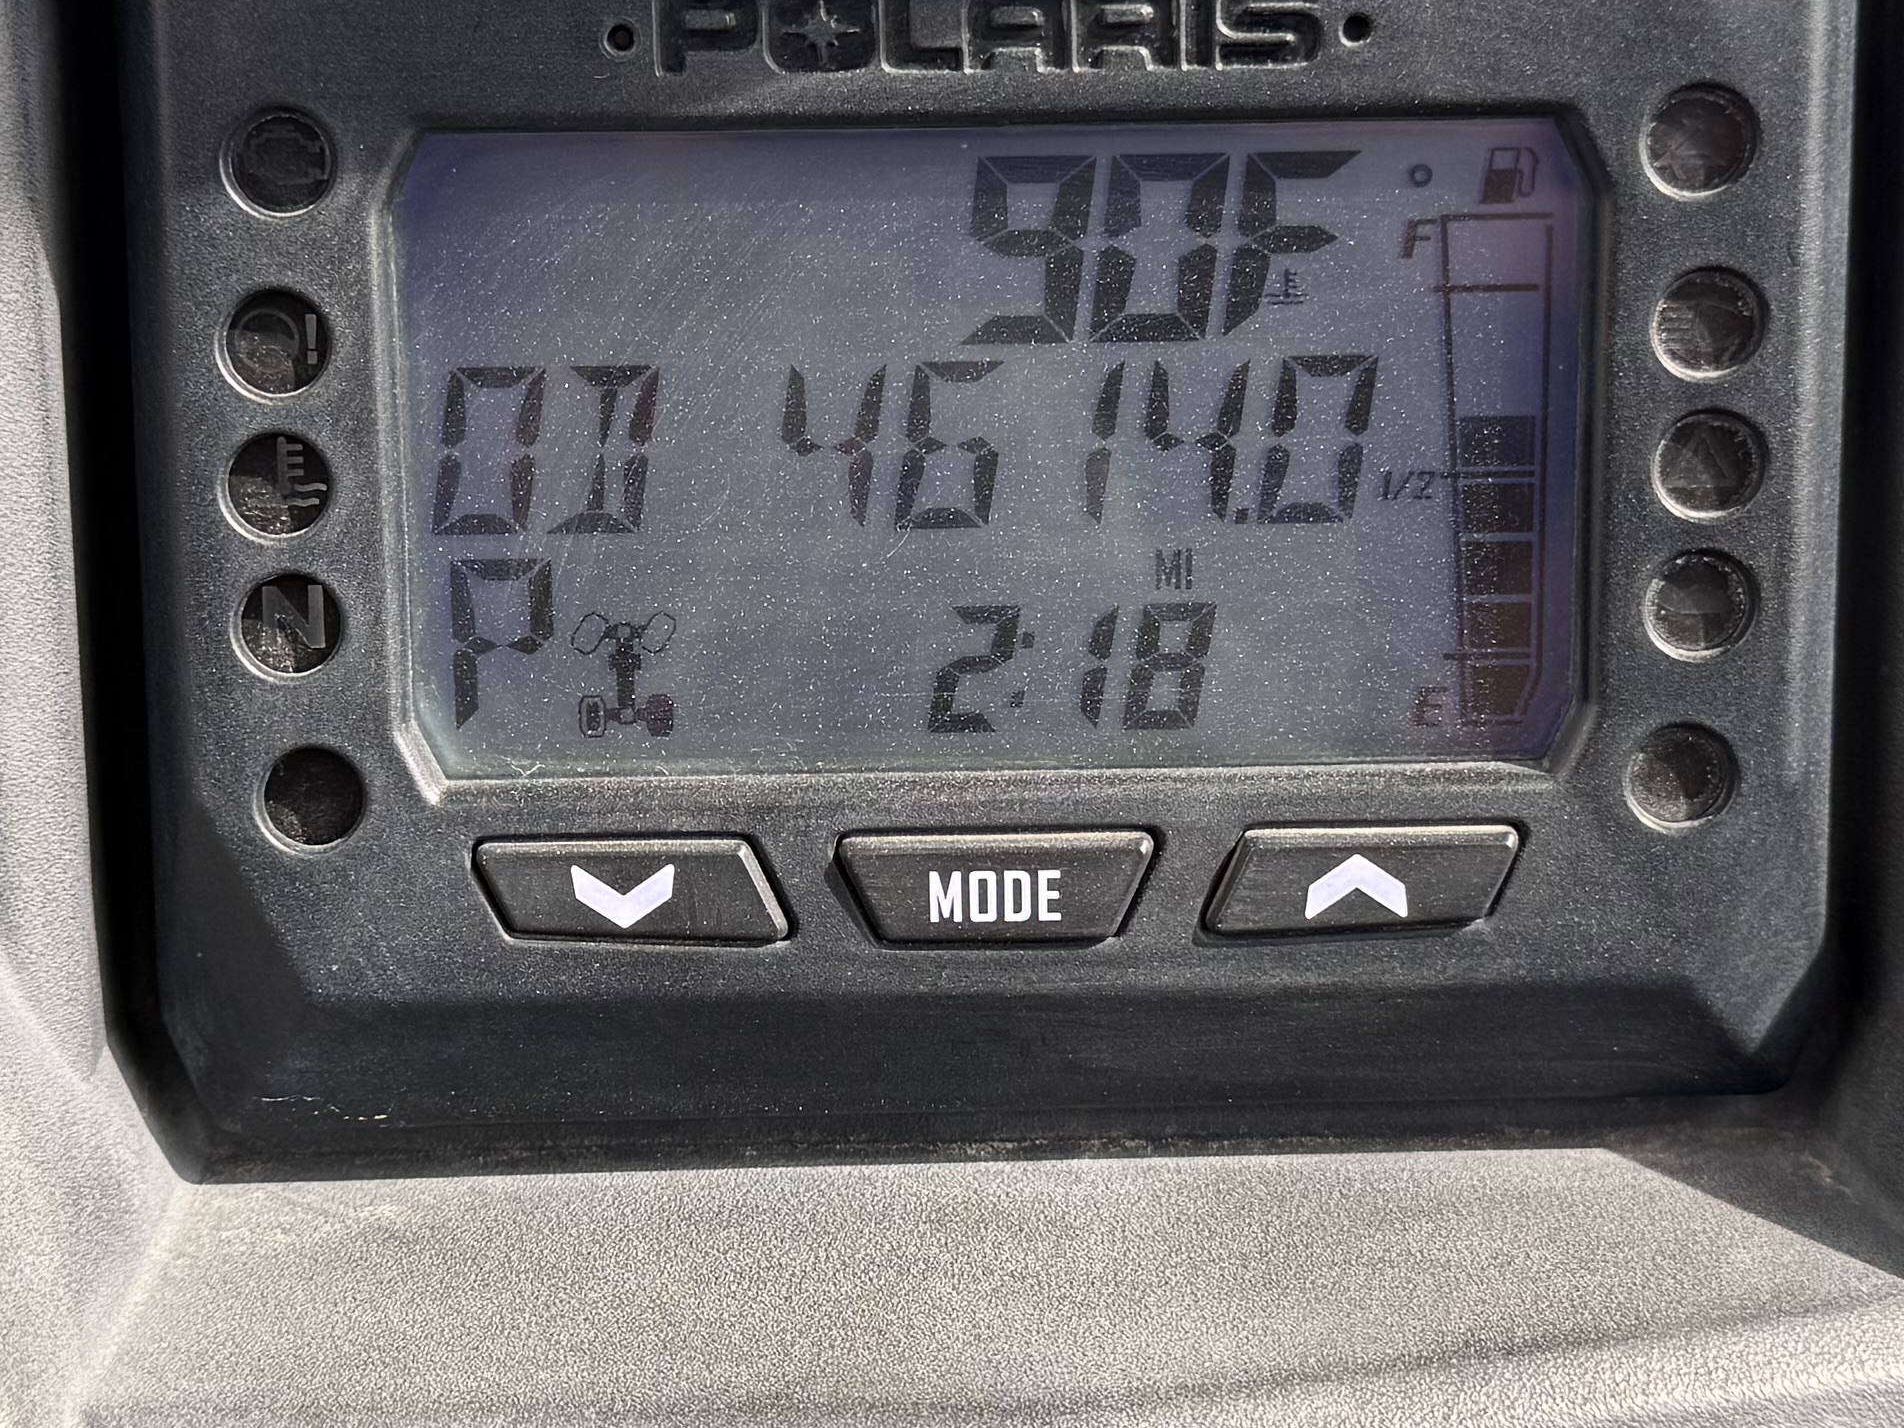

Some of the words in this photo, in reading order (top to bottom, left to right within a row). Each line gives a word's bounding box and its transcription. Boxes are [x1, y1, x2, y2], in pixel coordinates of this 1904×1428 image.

[961, 151, 1362, 344] 90F
[1402, 219, 1437, 259] F
[1382, 471, 1435, 500] 1/2
[1154, 548, 1194, 589] MI
[262, 584, 326, 648] N
[450, 559, 553, 729] P
[928, 602, 1217, 732] 2:18
[1412, 686, 1448, 727] E
[928, 869, 1063, 922] MODE
